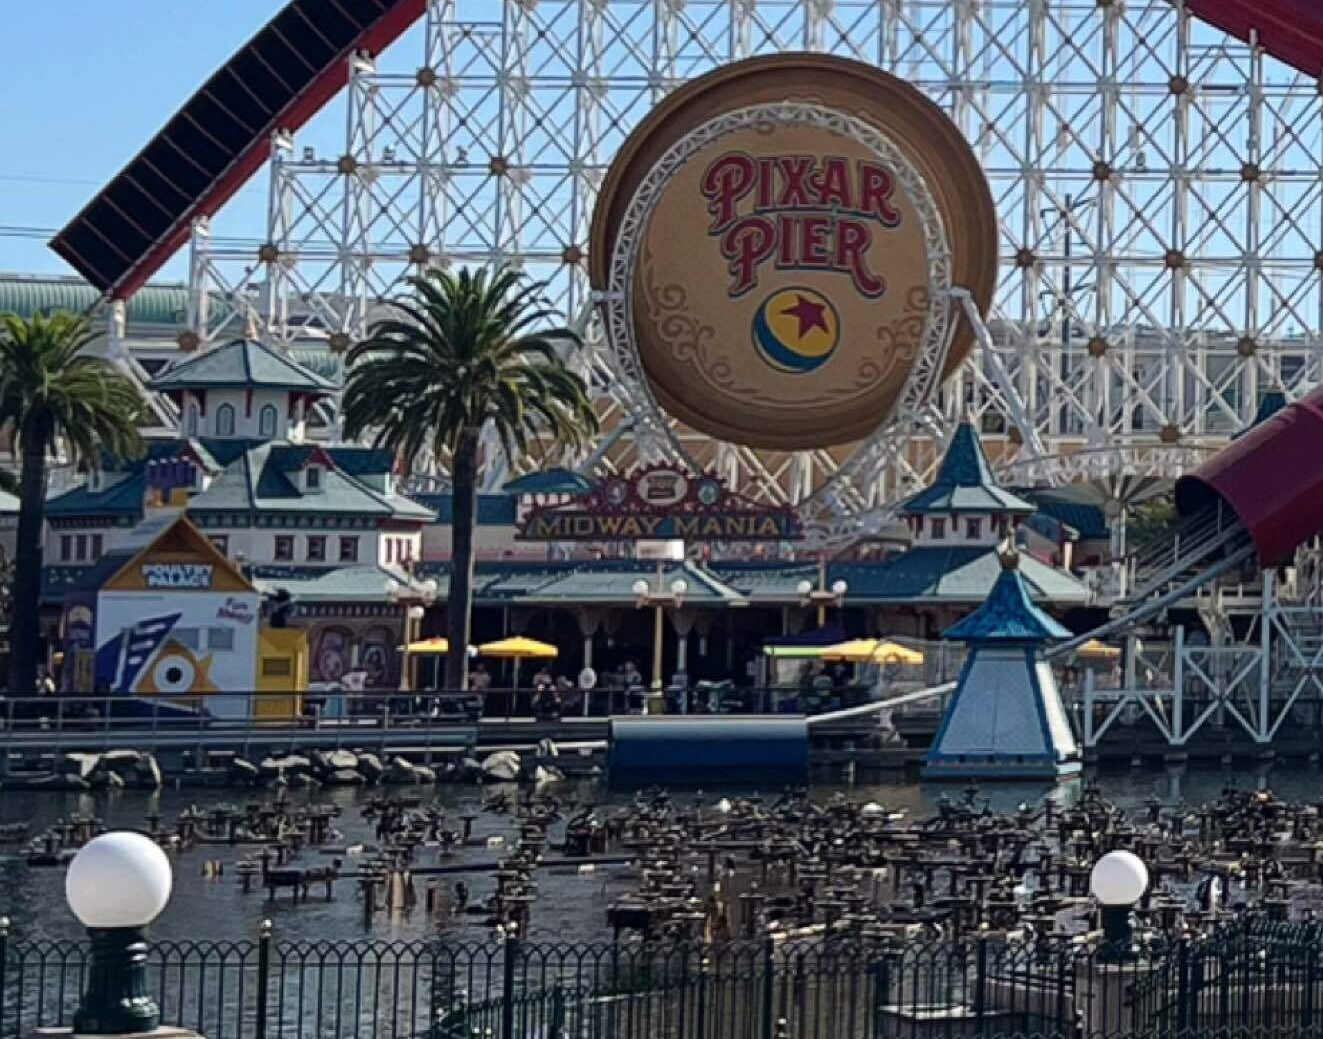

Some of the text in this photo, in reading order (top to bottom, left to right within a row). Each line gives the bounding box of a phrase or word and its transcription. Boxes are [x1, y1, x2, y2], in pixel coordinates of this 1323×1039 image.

[703, 151, 901, 236] PIXAR
[721, 213, 886, 298] PIER
[535, 516, 661, 536] MIDWAY
